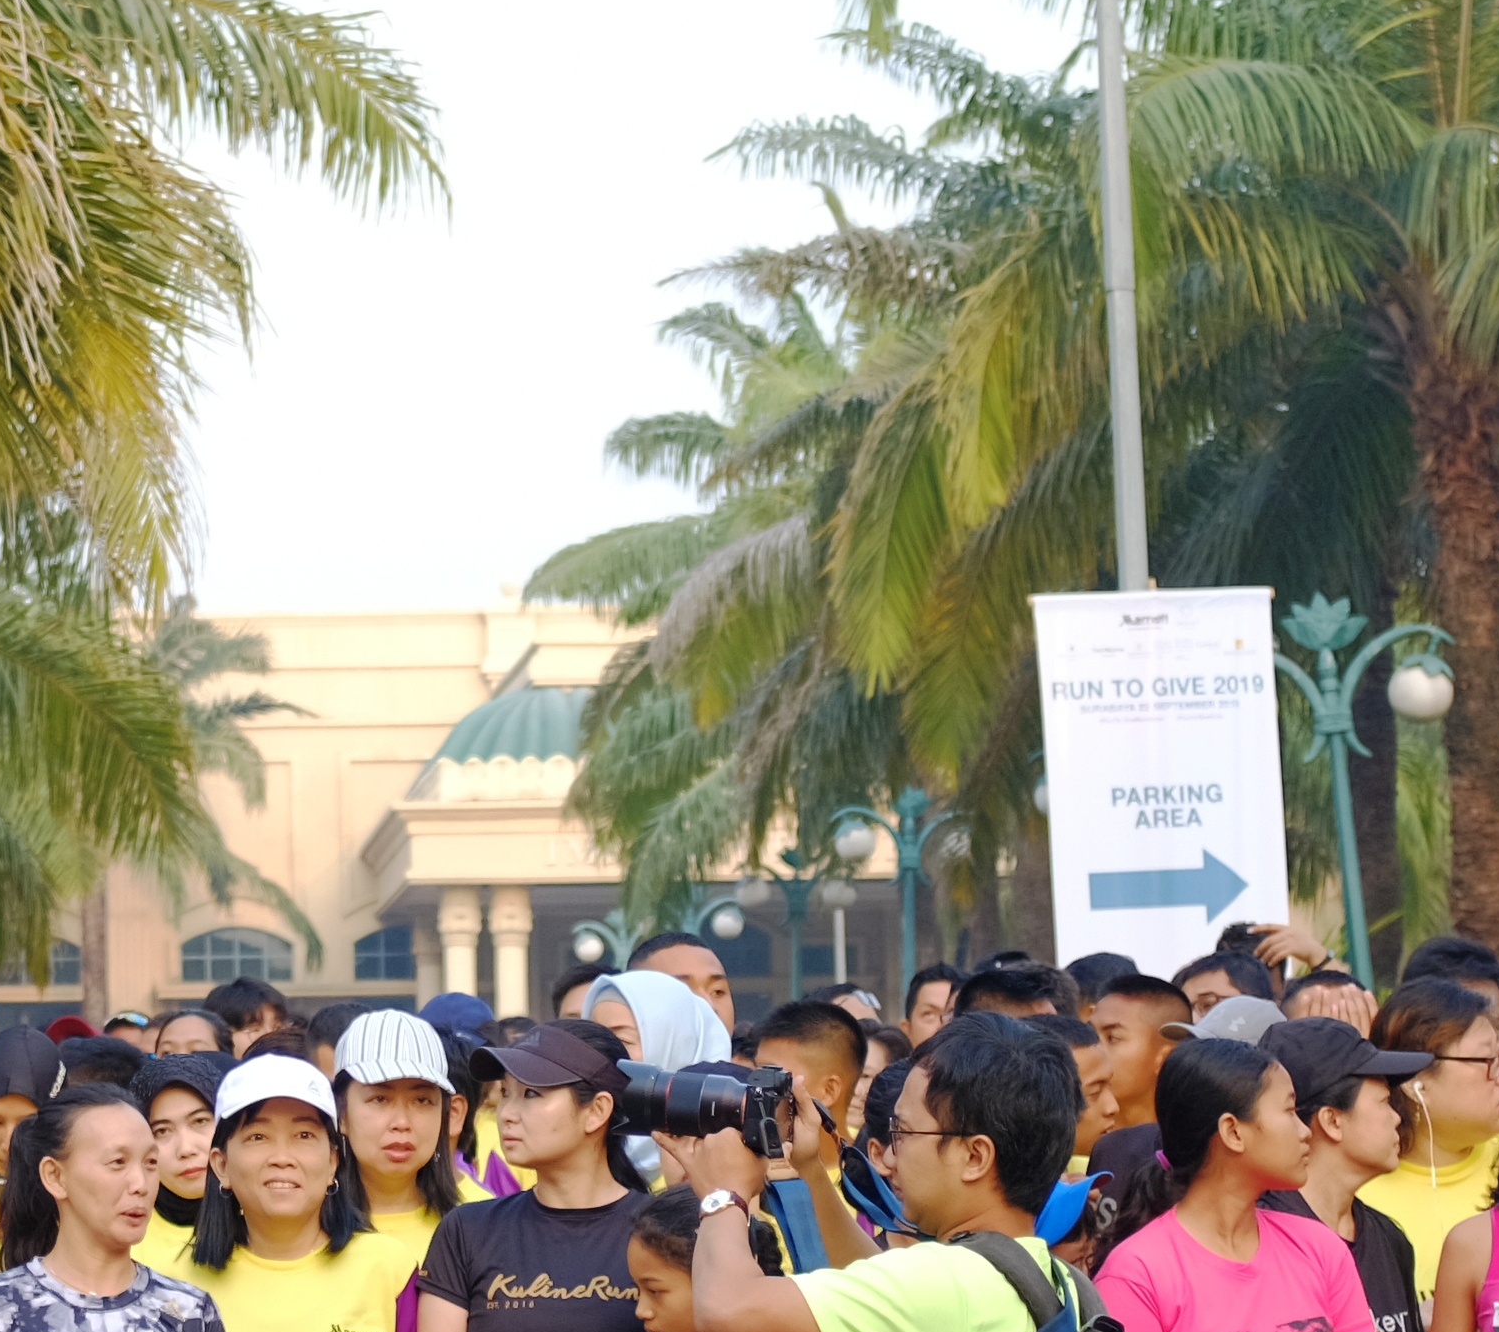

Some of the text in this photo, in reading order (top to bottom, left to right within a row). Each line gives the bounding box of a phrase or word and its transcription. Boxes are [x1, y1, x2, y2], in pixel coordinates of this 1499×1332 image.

[1052, 674, 1265, 701] RUN TO GIVE 2019
[1111, 782, 1223, 807] PARKING
[1135, 808, 1203, 830] AREA
